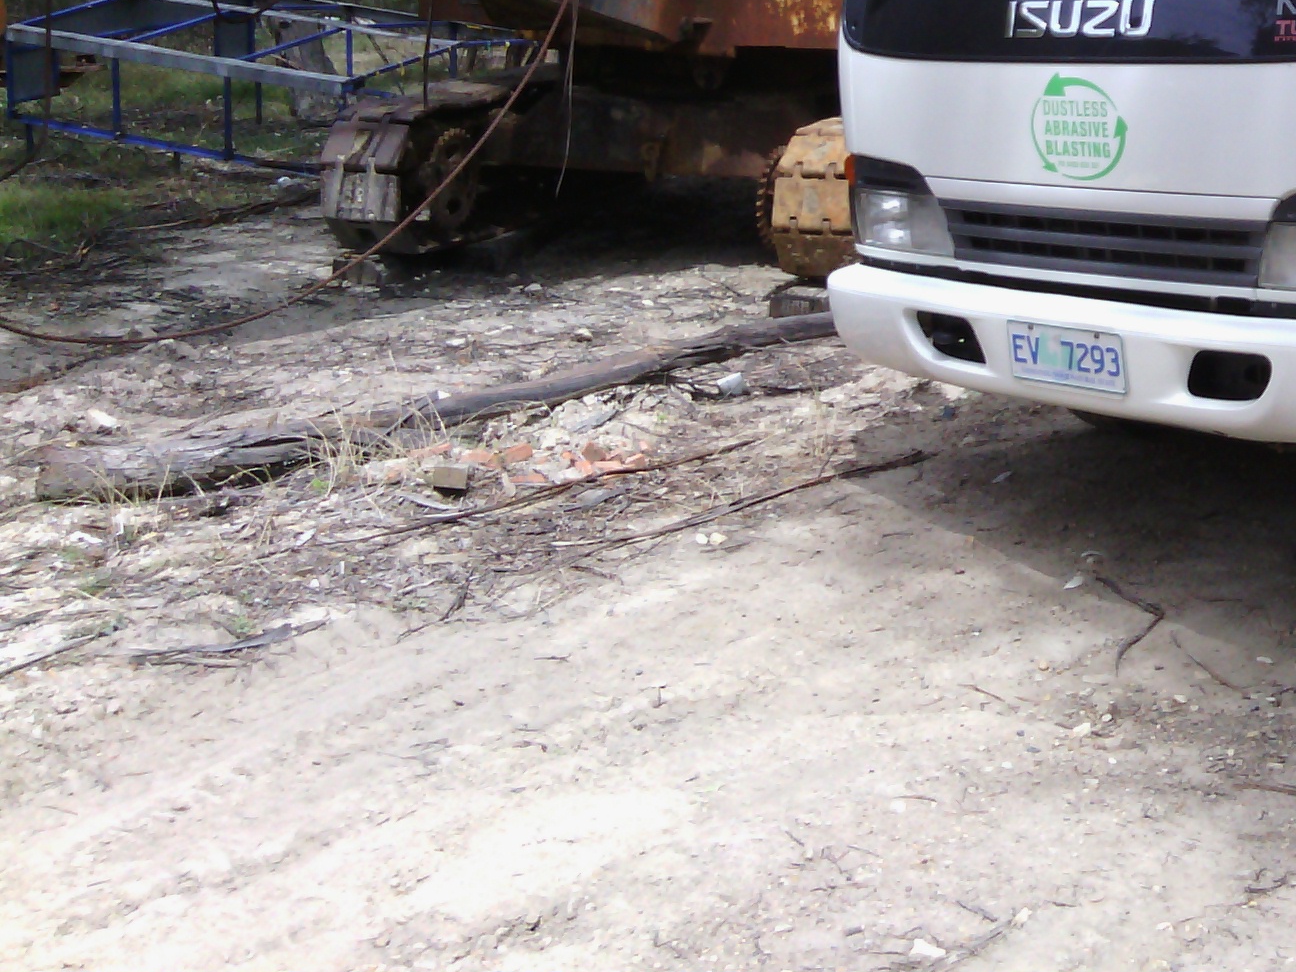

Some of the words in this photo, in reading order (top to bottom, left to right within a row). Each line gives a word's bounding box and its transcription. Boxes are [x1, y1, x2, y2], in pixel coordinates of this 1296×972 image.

[1043, 99, 1108, 118] DUSTLESS
[1044, 119, 1109, 138] ABRASIVE
[1045, 139, 1111, 158] BLASTING
[1012, 333, 1039, 365] EV
[1060, 340, 1120, 377] 7293
